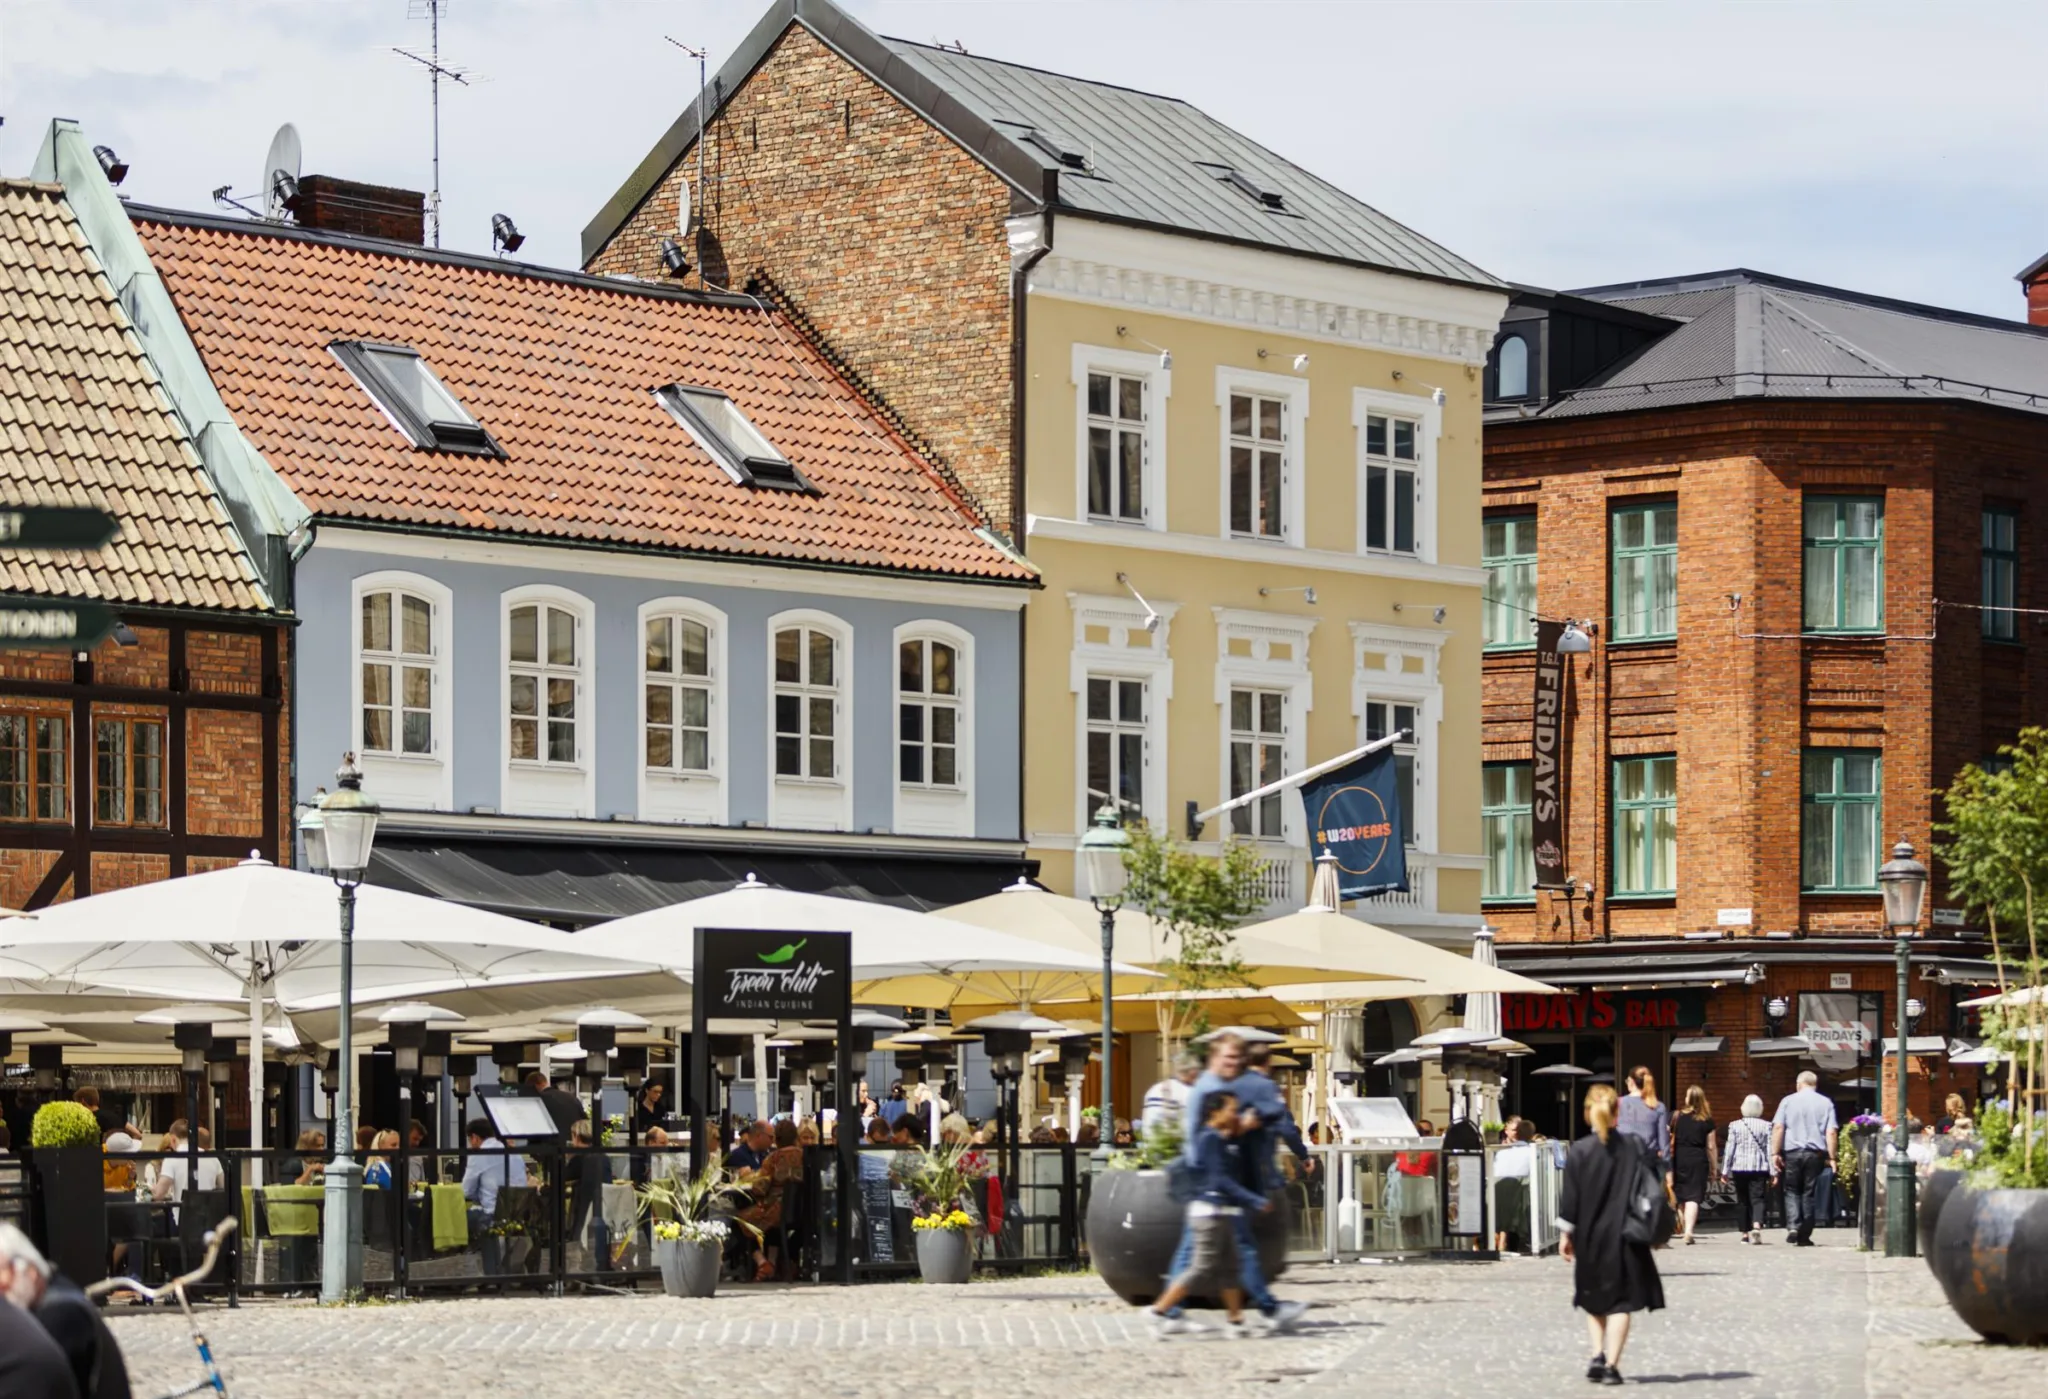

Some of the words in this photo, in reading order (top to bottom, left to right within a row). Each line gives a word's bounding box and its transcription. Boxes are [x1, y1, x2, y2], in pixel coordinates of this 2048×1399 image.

[736, 1000, 770, 1009] INDIAN
[774, 1000, 813, 1010] CUISINE
[1624, 999, 1681, 1028] BAR
